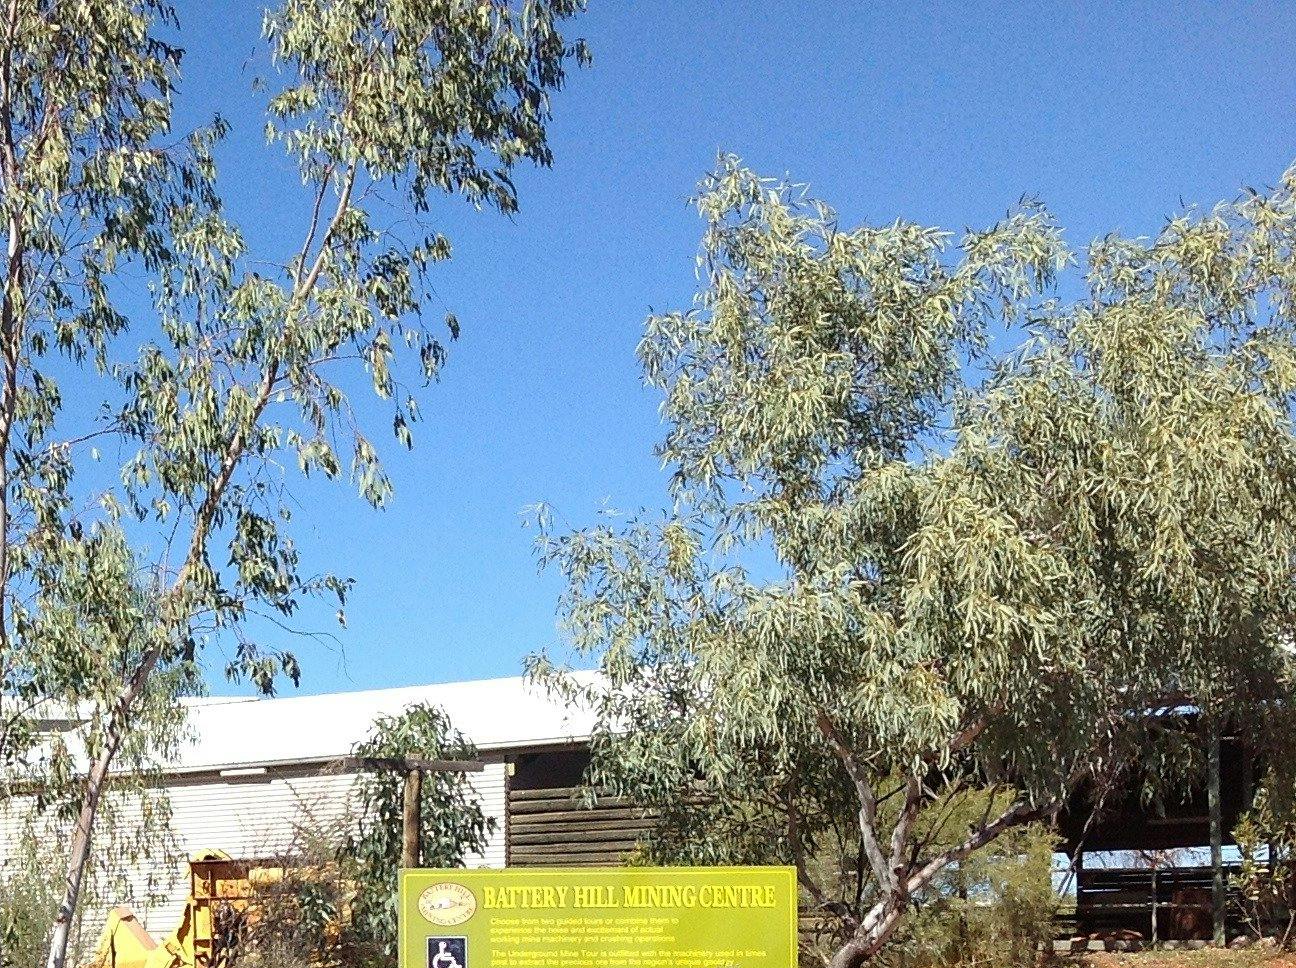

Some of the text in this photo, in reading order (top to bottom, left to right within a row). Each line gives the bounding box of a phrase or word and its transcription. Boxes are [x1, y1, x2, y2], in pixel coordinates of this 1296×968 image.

[483, 885, 777, 909] BATTERY HILL MINING CENTRE
[556, 917, 582, 927] guided
[584, 917, 603, 925] tours
[534, 926, 546, 934] the
[570, 926, 585, 934] and
[492, 949, 506, 957] The
[508, 949, 558, 959] Underground
[581, 949, 598, 957] Tour
[658, 949, 671, 957] the
[546, 958, 559, 966] the
